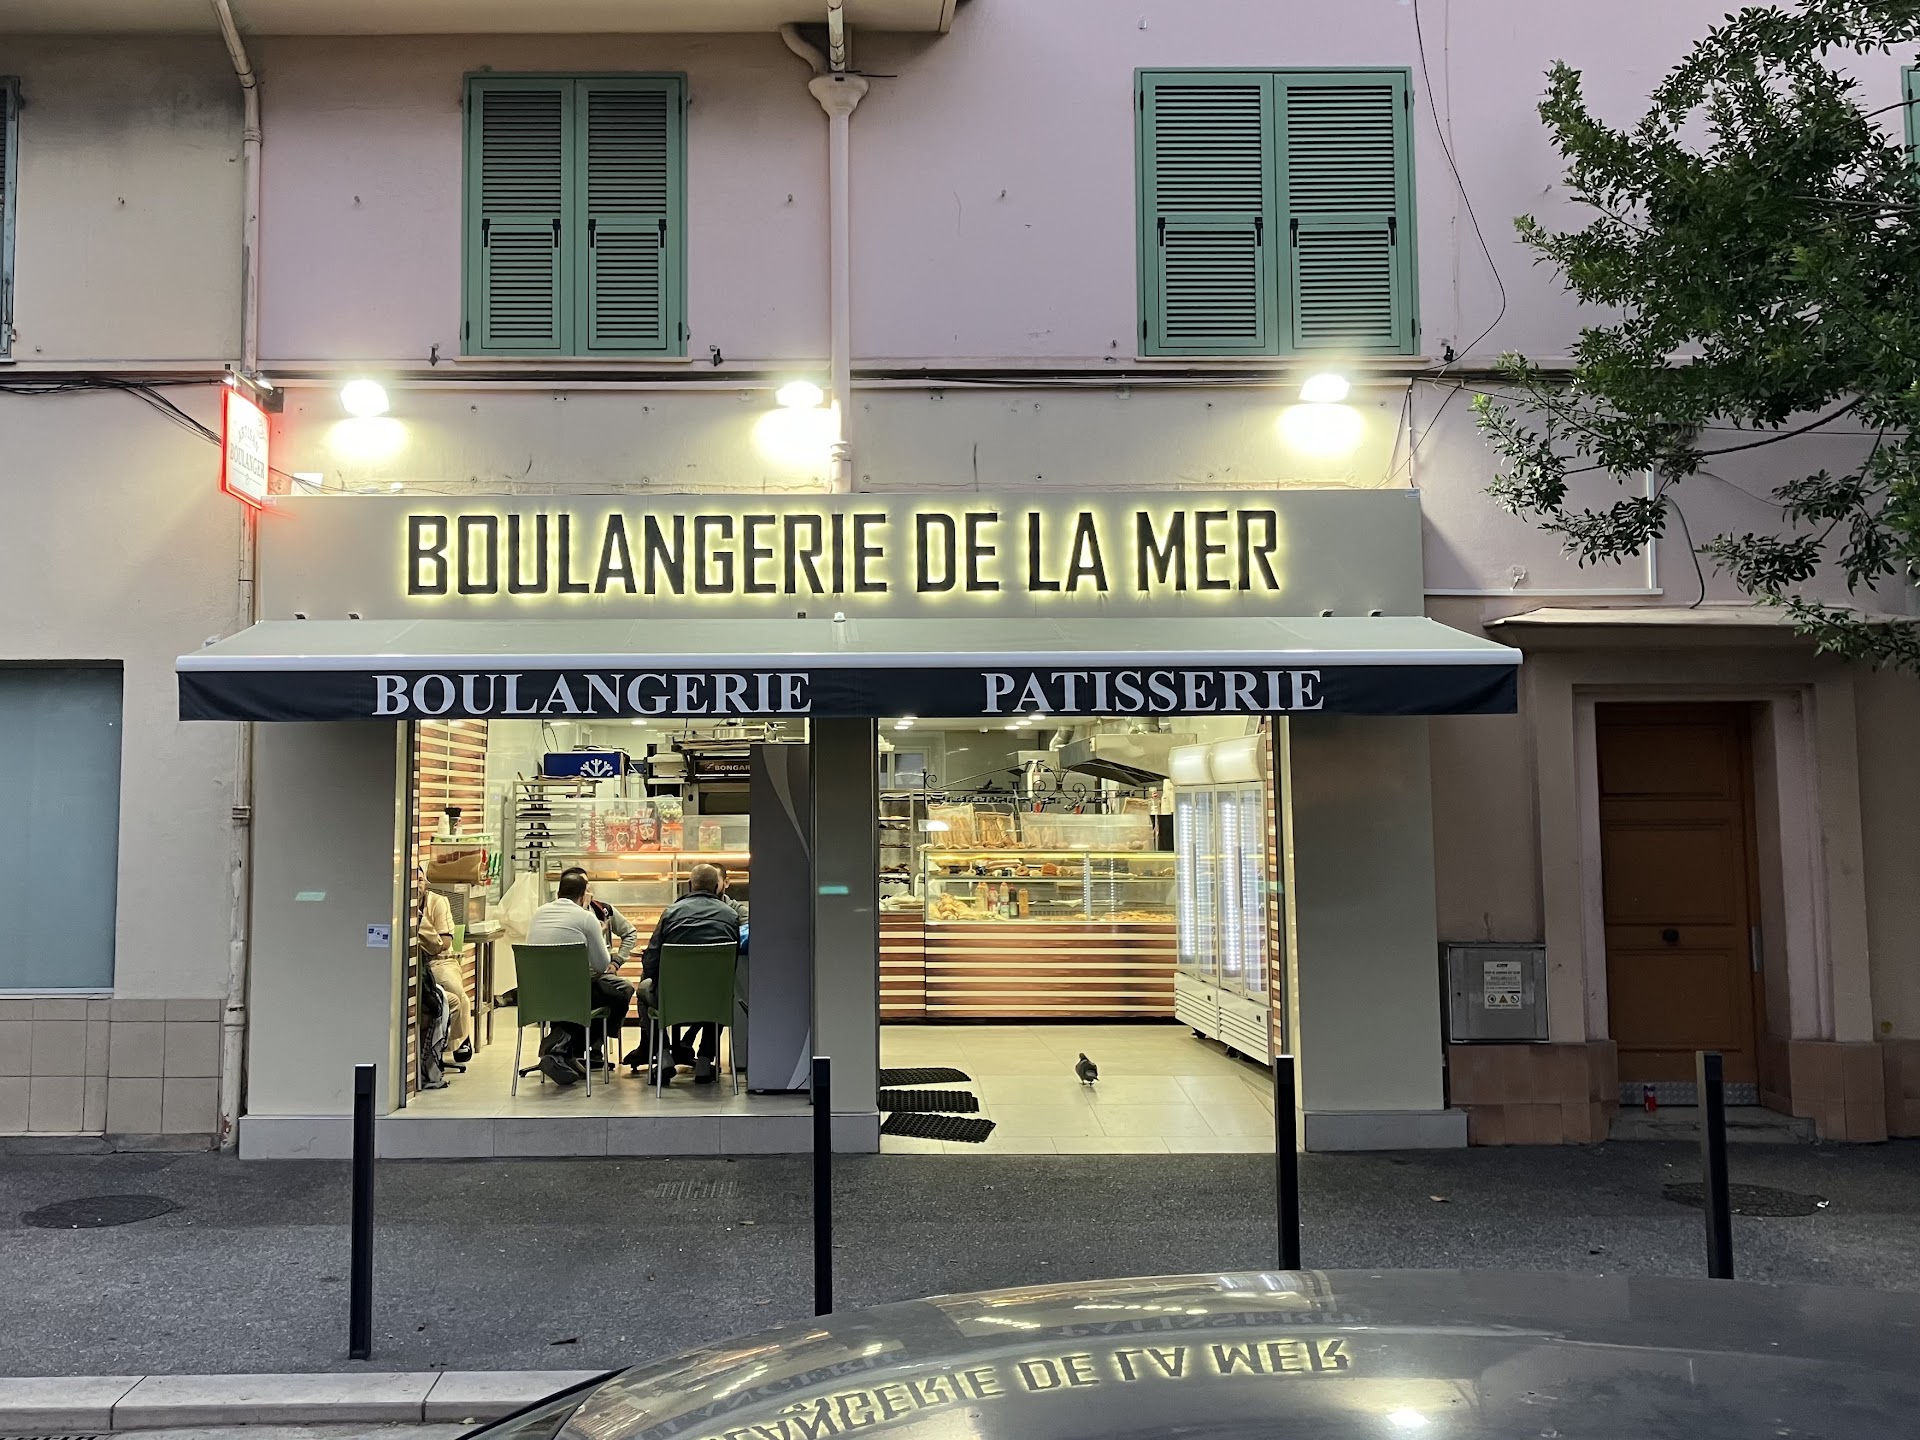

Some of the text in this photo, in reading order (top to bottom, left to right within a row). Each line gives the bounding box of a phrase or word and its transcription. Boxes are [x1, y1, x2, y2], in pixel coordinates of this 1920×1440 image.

[230, 442, 265, 479] BOULANGER
[407, 509, 1281, 596] BOULANGERIE DE LA MER
[371, 672, 812, 716] BOULANGERIE
[980, 669, 1325, 713] PATISSERIE
